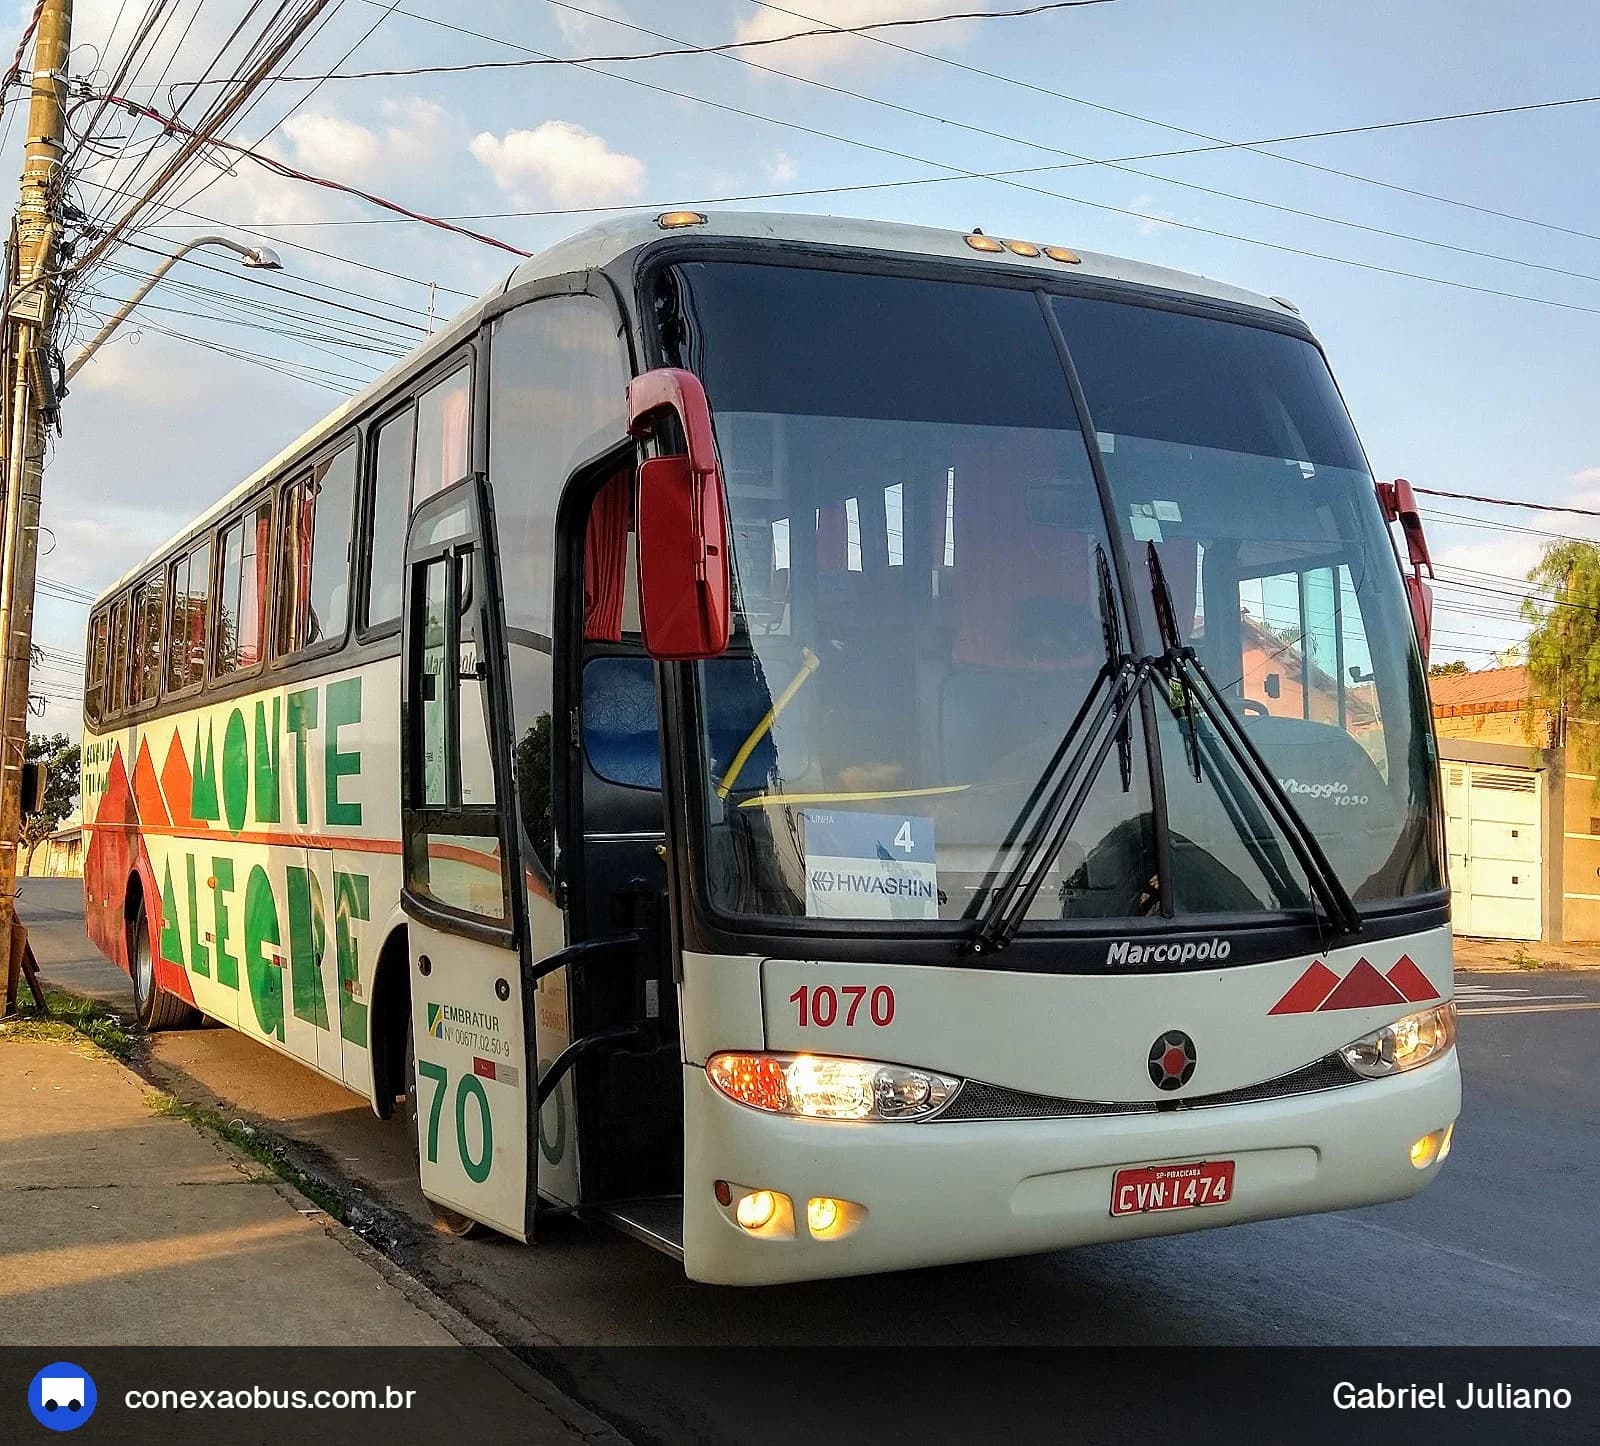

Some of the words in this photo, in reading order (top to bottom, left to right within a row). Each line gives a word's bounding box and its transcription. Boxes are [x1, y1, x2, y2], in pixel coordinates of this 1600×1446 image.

[191, 676, 362, 837] MONTE
[893, 820, 915, 853] 4
[837, 873, 932, 898] HWASHIN
[160, 852, 370, 1048] ALEGRE
[1106, 938, 1231, 965] Marcopolo
[443, 1004, 499, 1032] EMBRATUR
[789, 985, 896, 1028] 1070
[418, 1059, 493, 1183] 70
